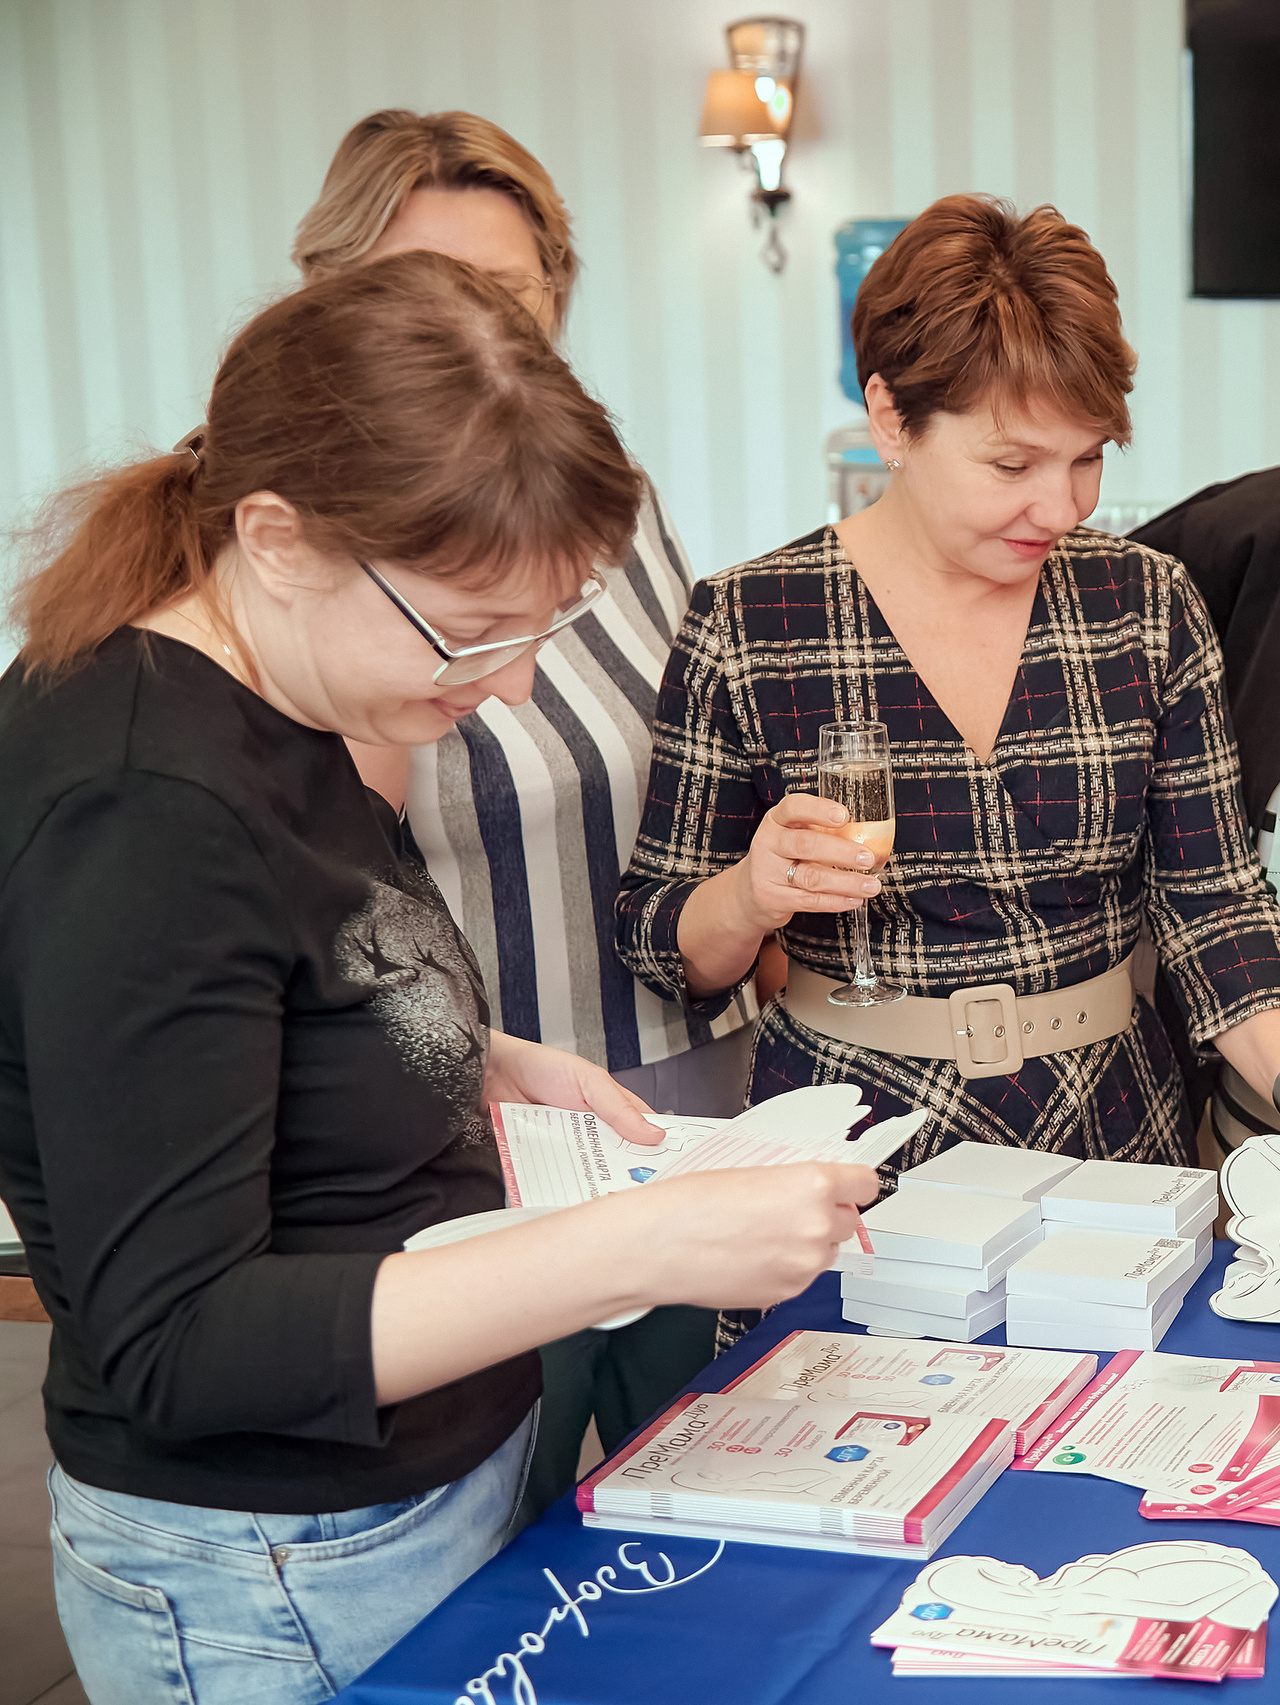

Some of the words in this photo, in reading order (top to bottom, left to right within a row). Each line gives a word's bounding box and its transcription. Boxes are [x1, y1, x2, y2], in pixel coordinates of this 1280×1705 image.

[583, 1114, 604, 1157] ОБМЕННАЯ
[595, 1158, 611, 1181] КАРТА
[780, 1352, 841, 1392] ПреМама
[621, 1415, 710, 1480] ПреМама
[683, 1401, 709, 1423] Дуо
[707, 1439, 726, 1453] 30
[775, 1446, 793, 1459] 30
[836, 1444, 859, 1462] ДГК
[955, 1625, 1108, 1655] ПреМама
